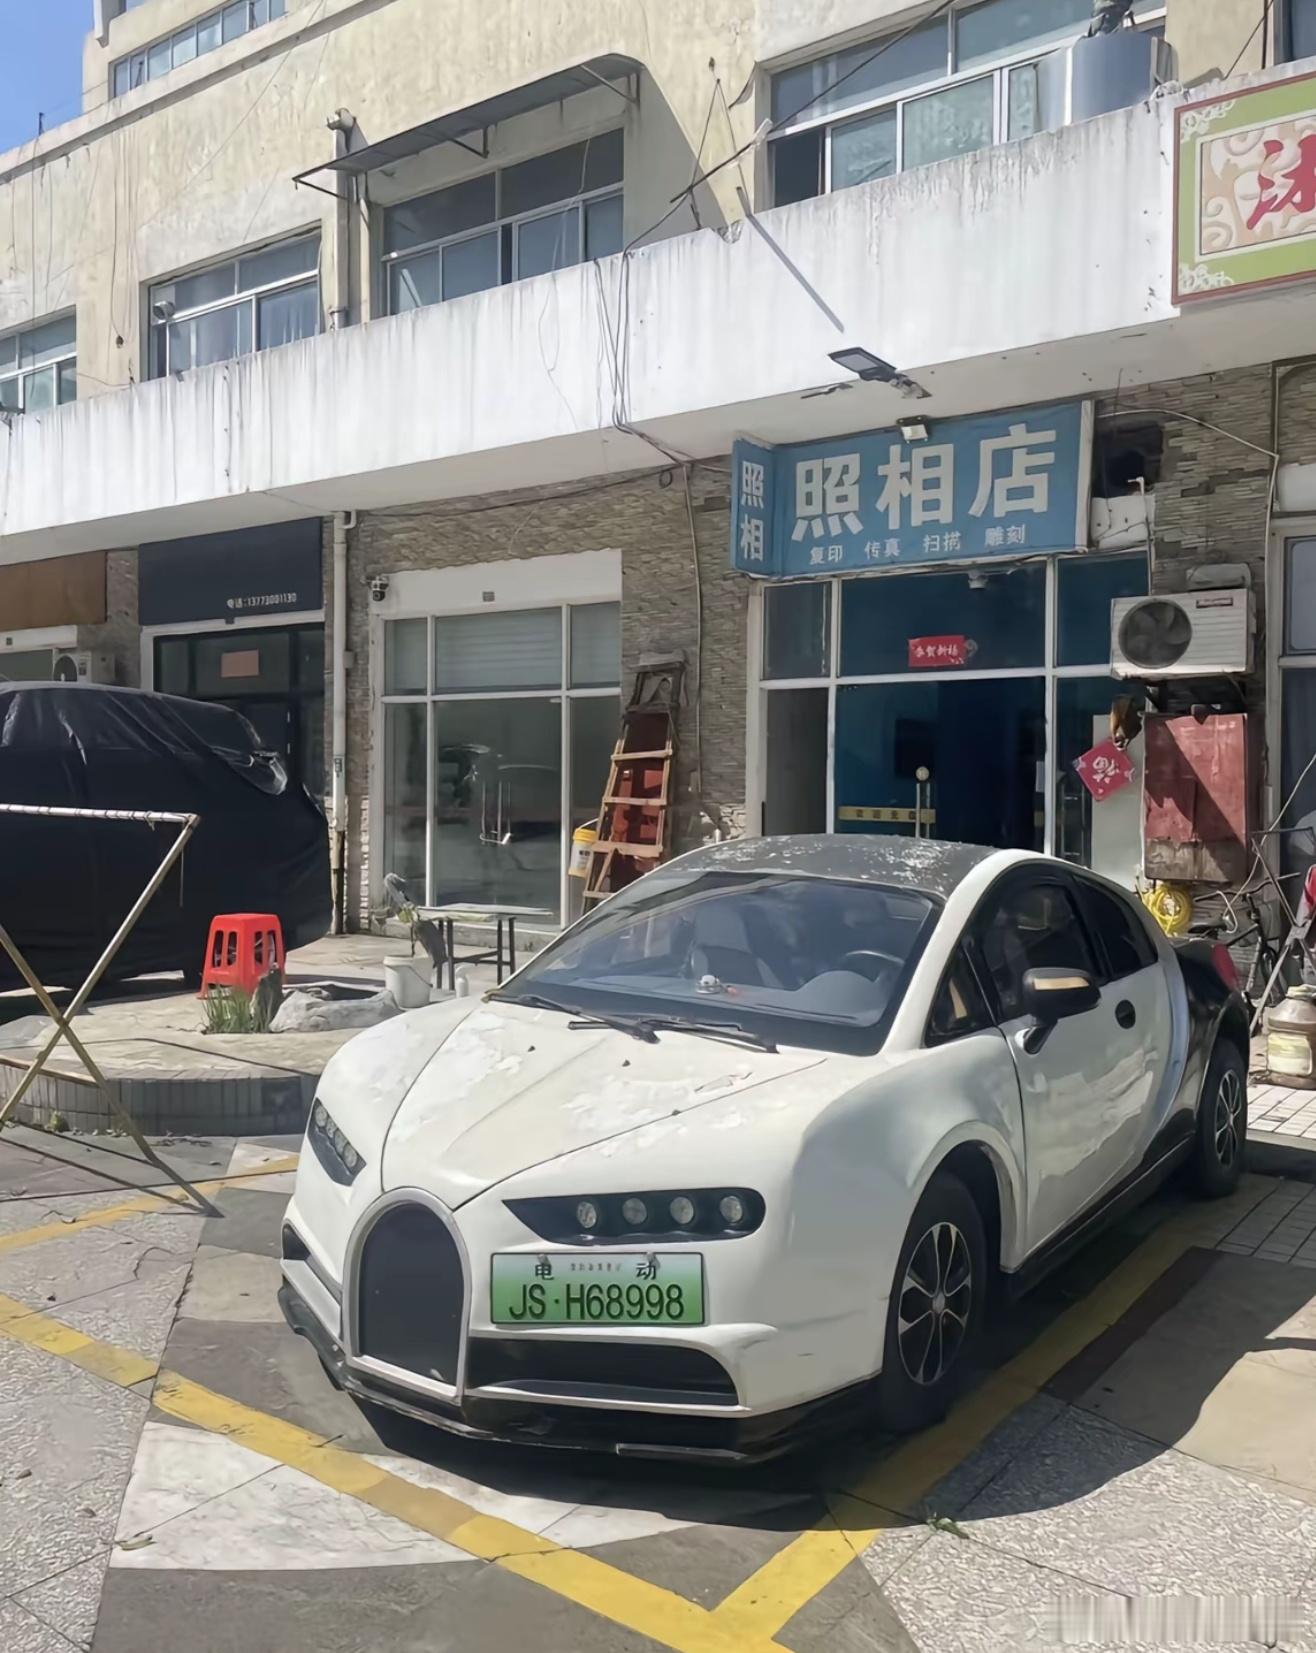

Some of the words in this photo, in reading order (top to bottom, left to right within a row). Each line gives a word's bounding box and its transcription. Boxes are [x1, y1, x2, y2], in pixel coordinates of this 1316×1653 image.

[741, 460, 764, 561] 照相
[791, 423, 1056, 542] 照相店
[809, 545, 843, 565] 复印
[864, 537, 900, 560] 传真
[984, 524, 1026, 546] 雕刻
[535, 1263, 554, 1280] 电
[636, 1262, 657, 1280] 动
